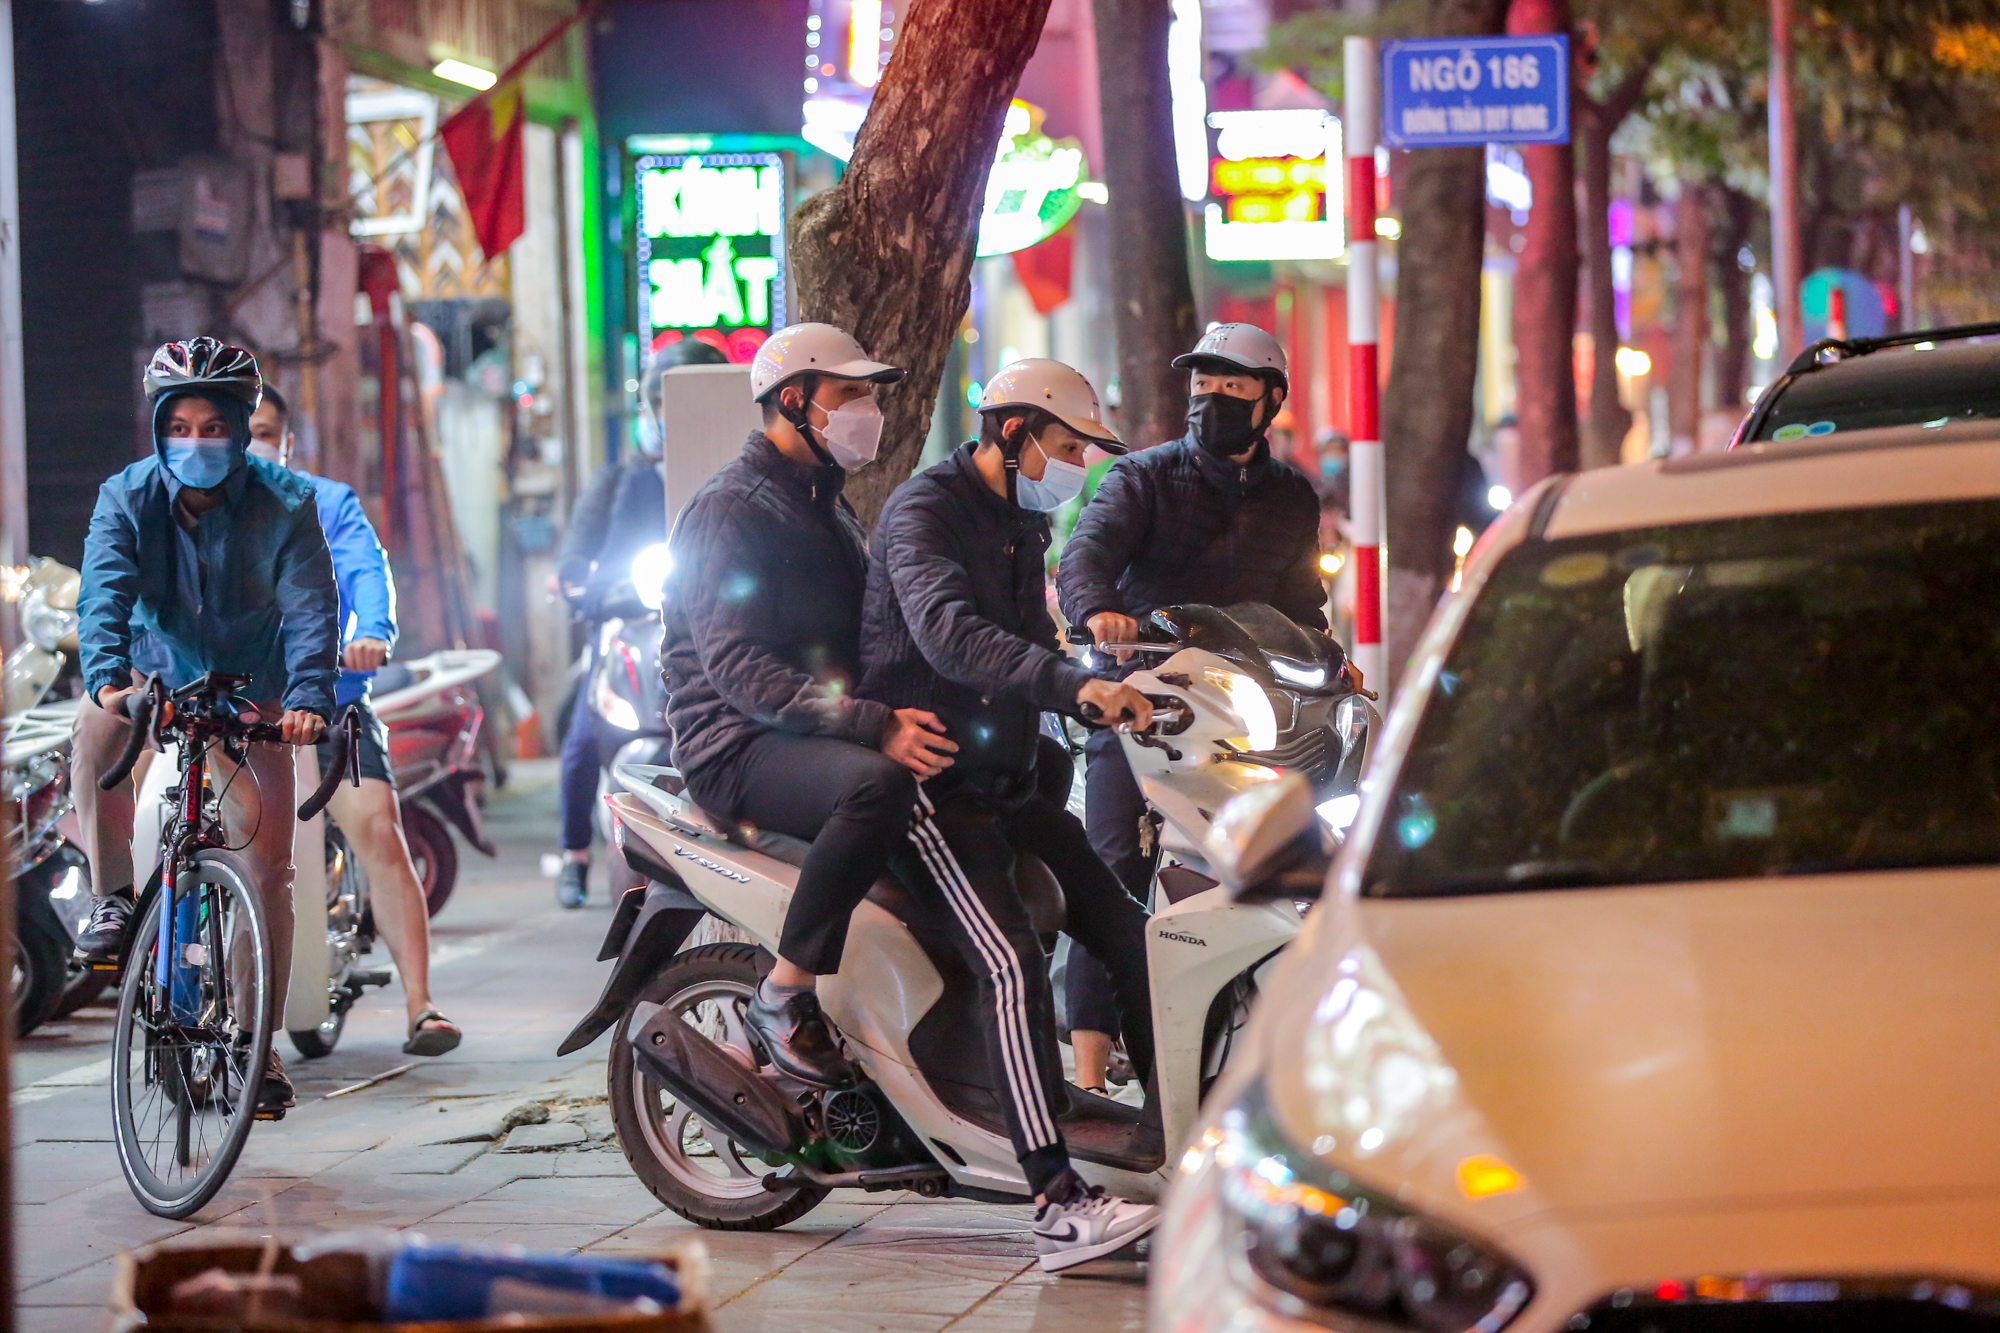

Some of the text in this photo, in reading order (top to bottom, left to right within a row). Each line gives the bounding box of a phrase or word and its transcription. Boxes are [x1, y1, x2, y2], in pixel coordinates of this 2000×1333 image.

[1487, 53, 1540, 89] 186
[673, 844, 751, 883] VISION
[1158, 930, 1207, 947] HONDA
